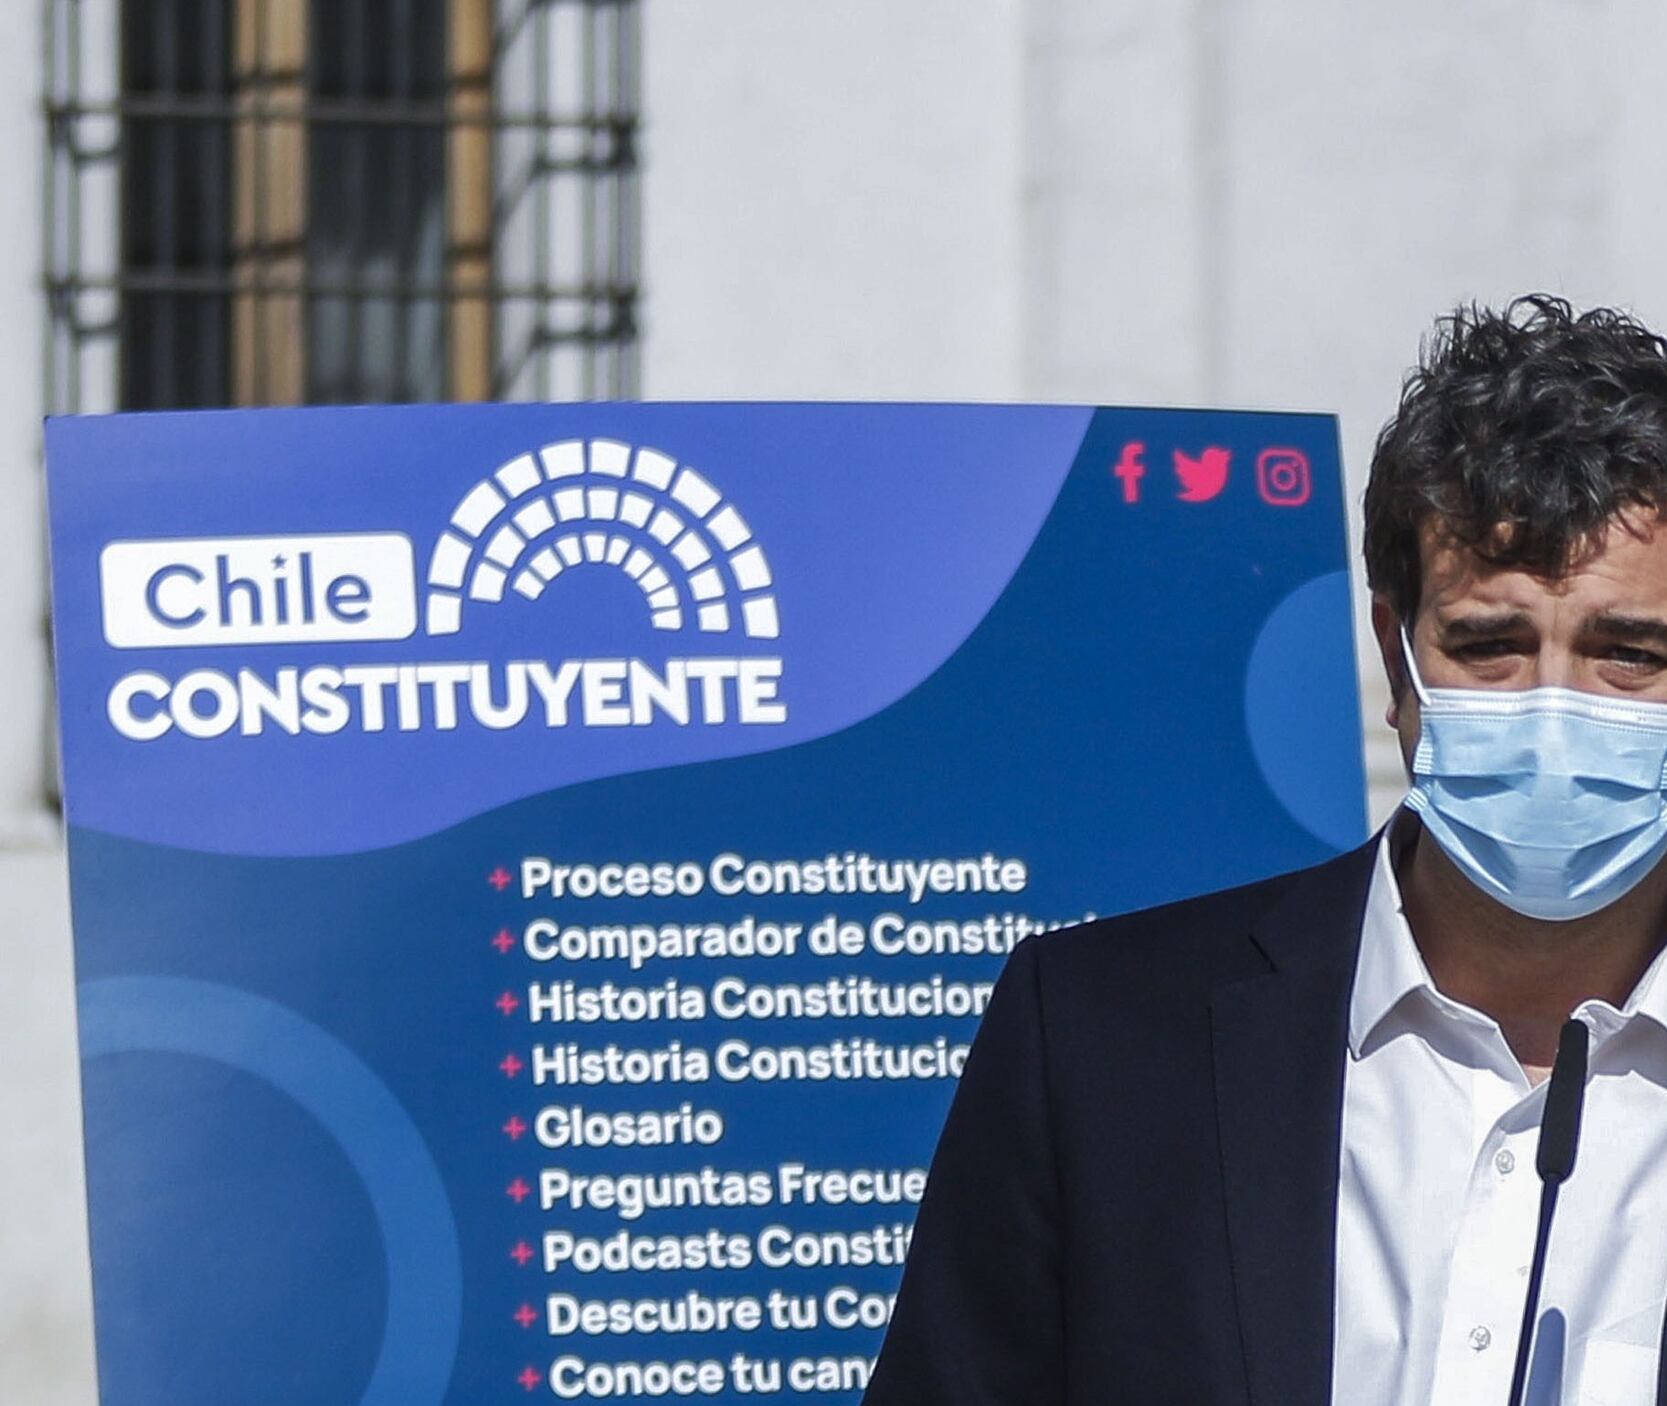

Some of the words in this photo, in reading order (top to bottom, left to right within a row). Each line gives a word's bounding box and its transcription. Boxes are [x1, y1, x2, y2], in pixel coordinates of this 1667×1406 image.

[144, 551, 372, 630] Chile
[105, 657, 787, 743] CONSTITUYENTE
[520, 858, 703, 898] Proceso
[709, 852, 1029, 903] Constituyente
[523, 917, 803, 968] Comparador
[808, 916, 865, 955] de
[527, 978, 706, 1023] Historia
[532, 1040, 708, 1085] Historia
[534, 1102, 724, 1150] Glosario
[539, 1165, 772, 1218] Preguntas
[777, 1163, 928, 1204] Frecue
[543, 1229, 752, 1274] Podcasts
[547, 1291, 762, 1336] Descubre
[768, 1292, 818, 1331] tu
[549, 1354, 725, 1399] Conoce
[731, 1353, 780, 1394] tu
